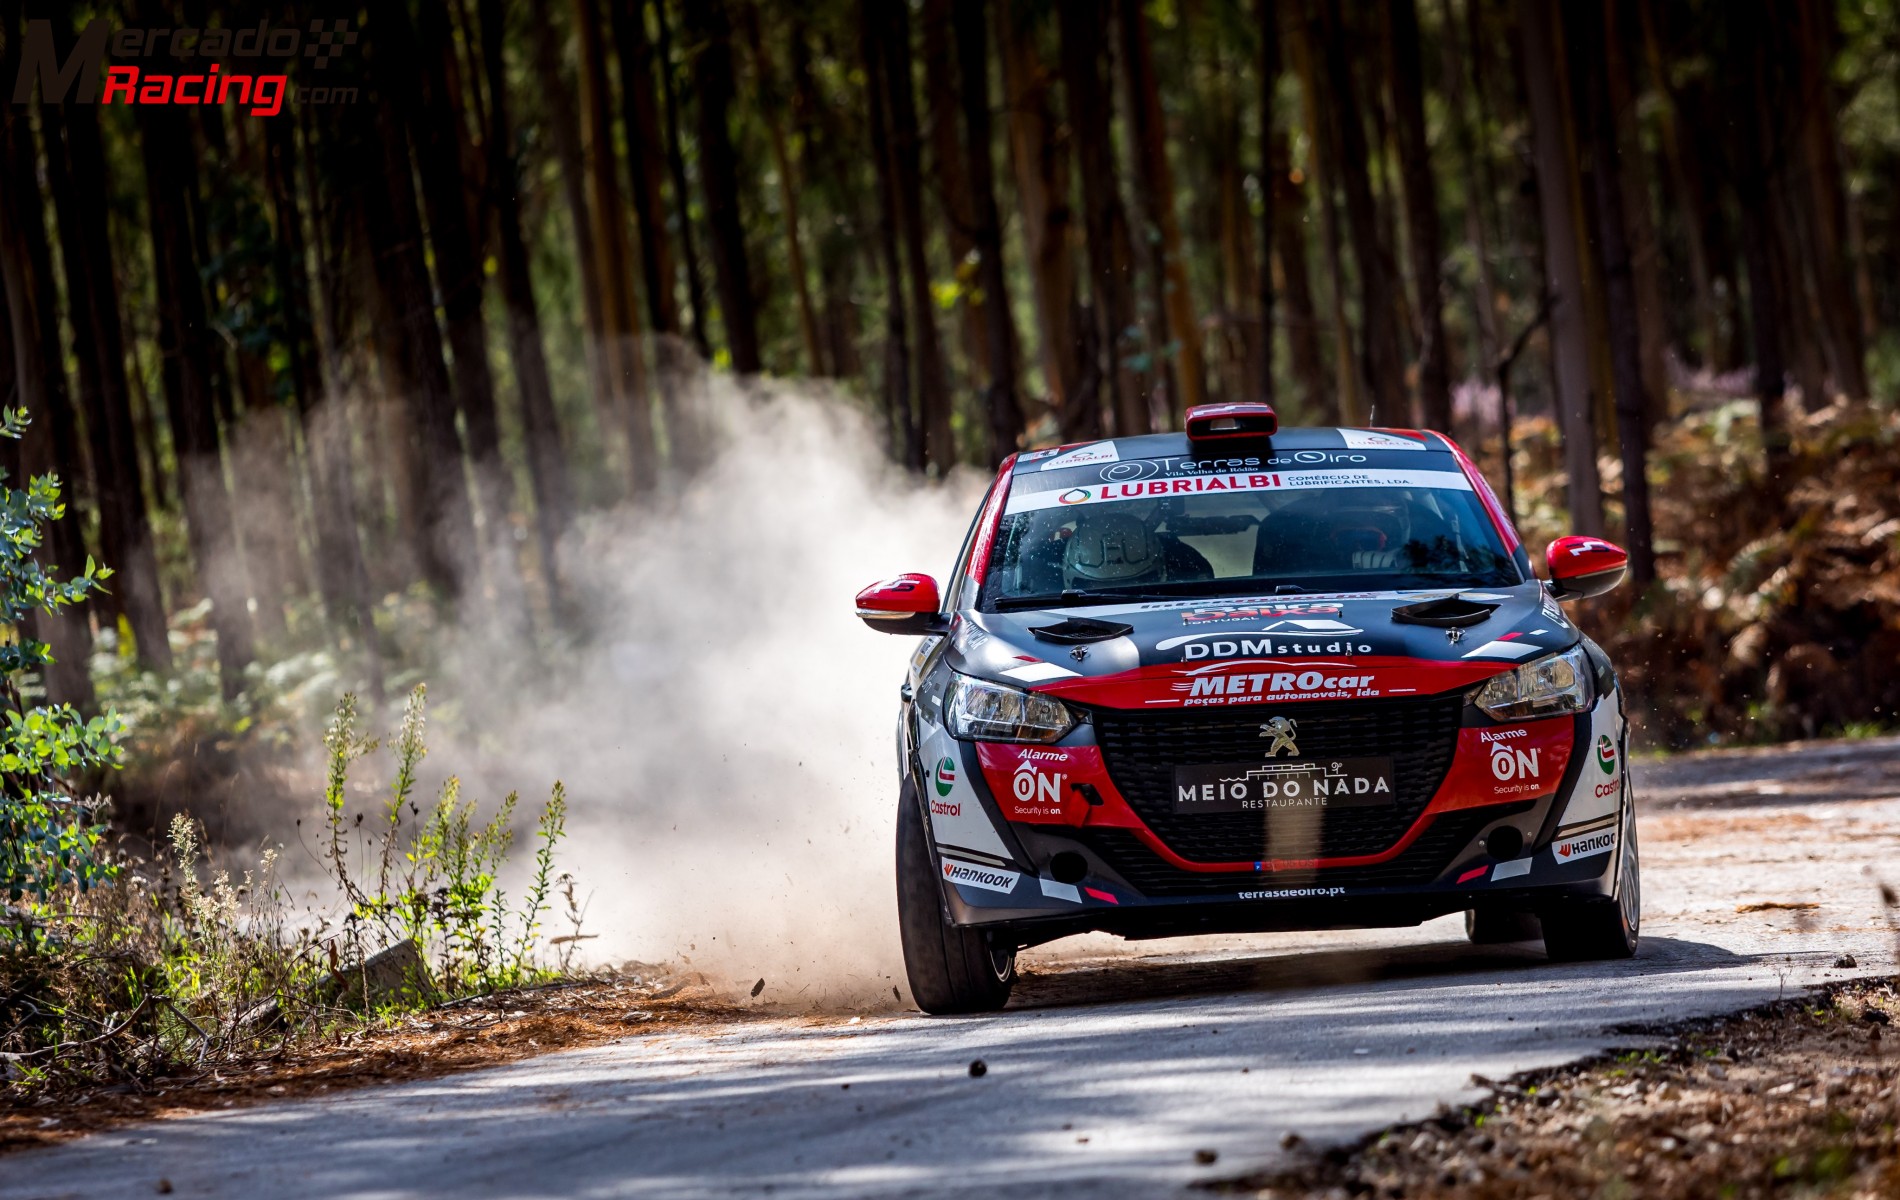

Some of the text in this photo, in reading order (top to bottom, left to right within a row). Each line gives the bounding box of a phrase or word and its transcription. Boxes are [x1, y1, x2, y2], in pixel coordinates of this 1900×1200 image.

[1155, 457, 1260, 471] Terras
[1267, 457, 1292, 465] de
[1165, 469, 1185, 477] Vila
[1187, 468, 1213, 476] Velha
[1100, 474, 1281, 500] LUBRIALBI
[1190, 672, 1375, 697] METROcar
[1184, 688, 1380, 707] peças para automoveis, lda
[1480, 728, 1528, 743] Alarme
[1018, 748, 1069, 762] Alarme
[1178, 776, 1390, 802] MEIO DO NADA
[1493, 784, 1523, 795] Security
[1524, 783, 1530, 791] is
[930, 799, 961, 817] Castrol
[1242, 797, 1328, 809] RESTAURANTE
[1014, 805, 1042, 816] Security
[1042, 806, 1049, 815] is
[1238, 886, 1345, 900] terrasdeoiro.pt
